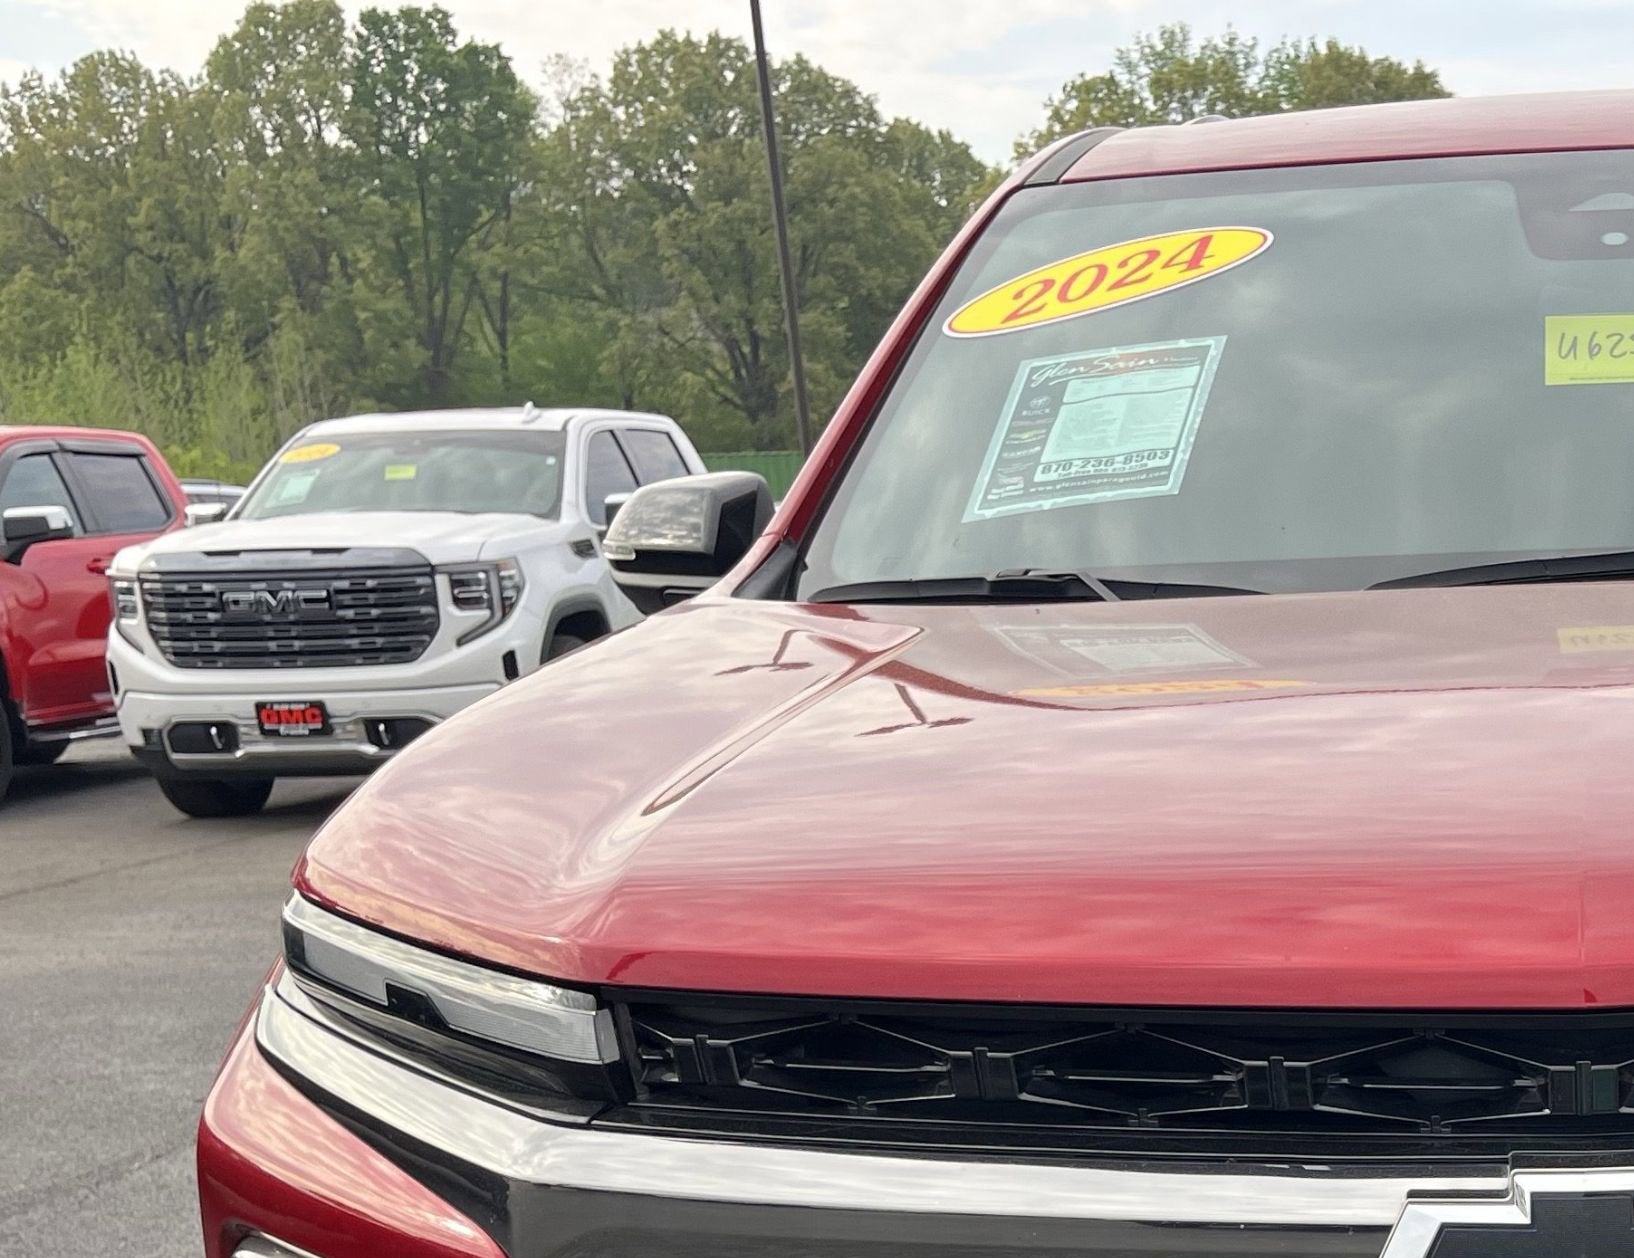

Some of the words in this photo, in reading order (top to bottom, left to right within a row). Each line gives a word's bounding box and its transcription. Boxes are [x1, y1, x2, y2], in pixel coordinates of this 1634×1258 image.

[1000, 235, 1215, 324] 2024
[1031, 361, 1088, 388] Glen
[1088, 354, 1160, 374] Sain
[1040, 450, 1170, 475] 870-236-8503
[222, 590, 329, 611] GMC
[261, 707, 322, 726] GMC
